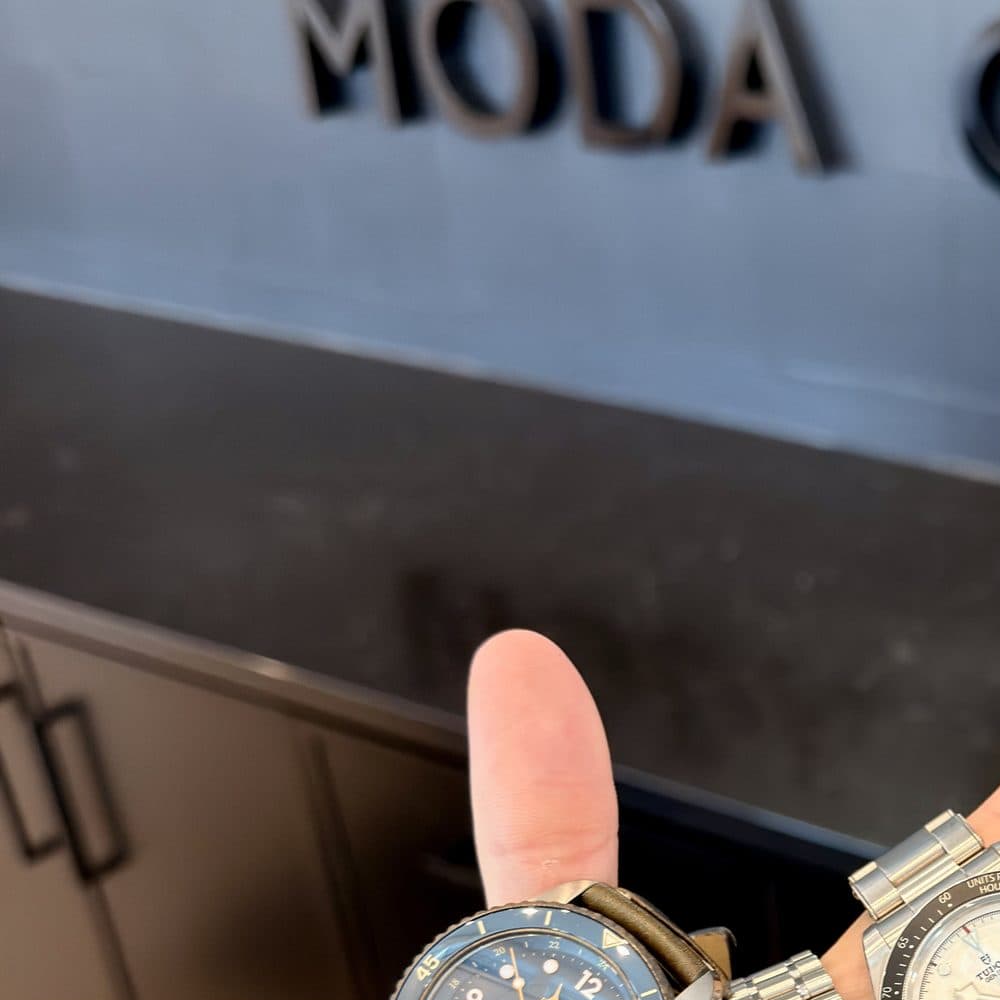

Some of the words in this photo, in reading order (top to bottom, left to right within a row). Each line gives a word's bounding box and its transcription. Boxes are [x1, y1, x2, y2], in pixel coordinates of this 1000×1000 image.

[288, 0, 852, 178] MODA
[967, 873, 996, 888] UNITS
[938, 892, 952, 904] 60
[547, 939, 561, 950] 22
[897, 936, 909, 949] 65
[415, 954, 441, 981] 45
[574, 968, 604, 1000] 12
[882, 986, 892, 999] 70
